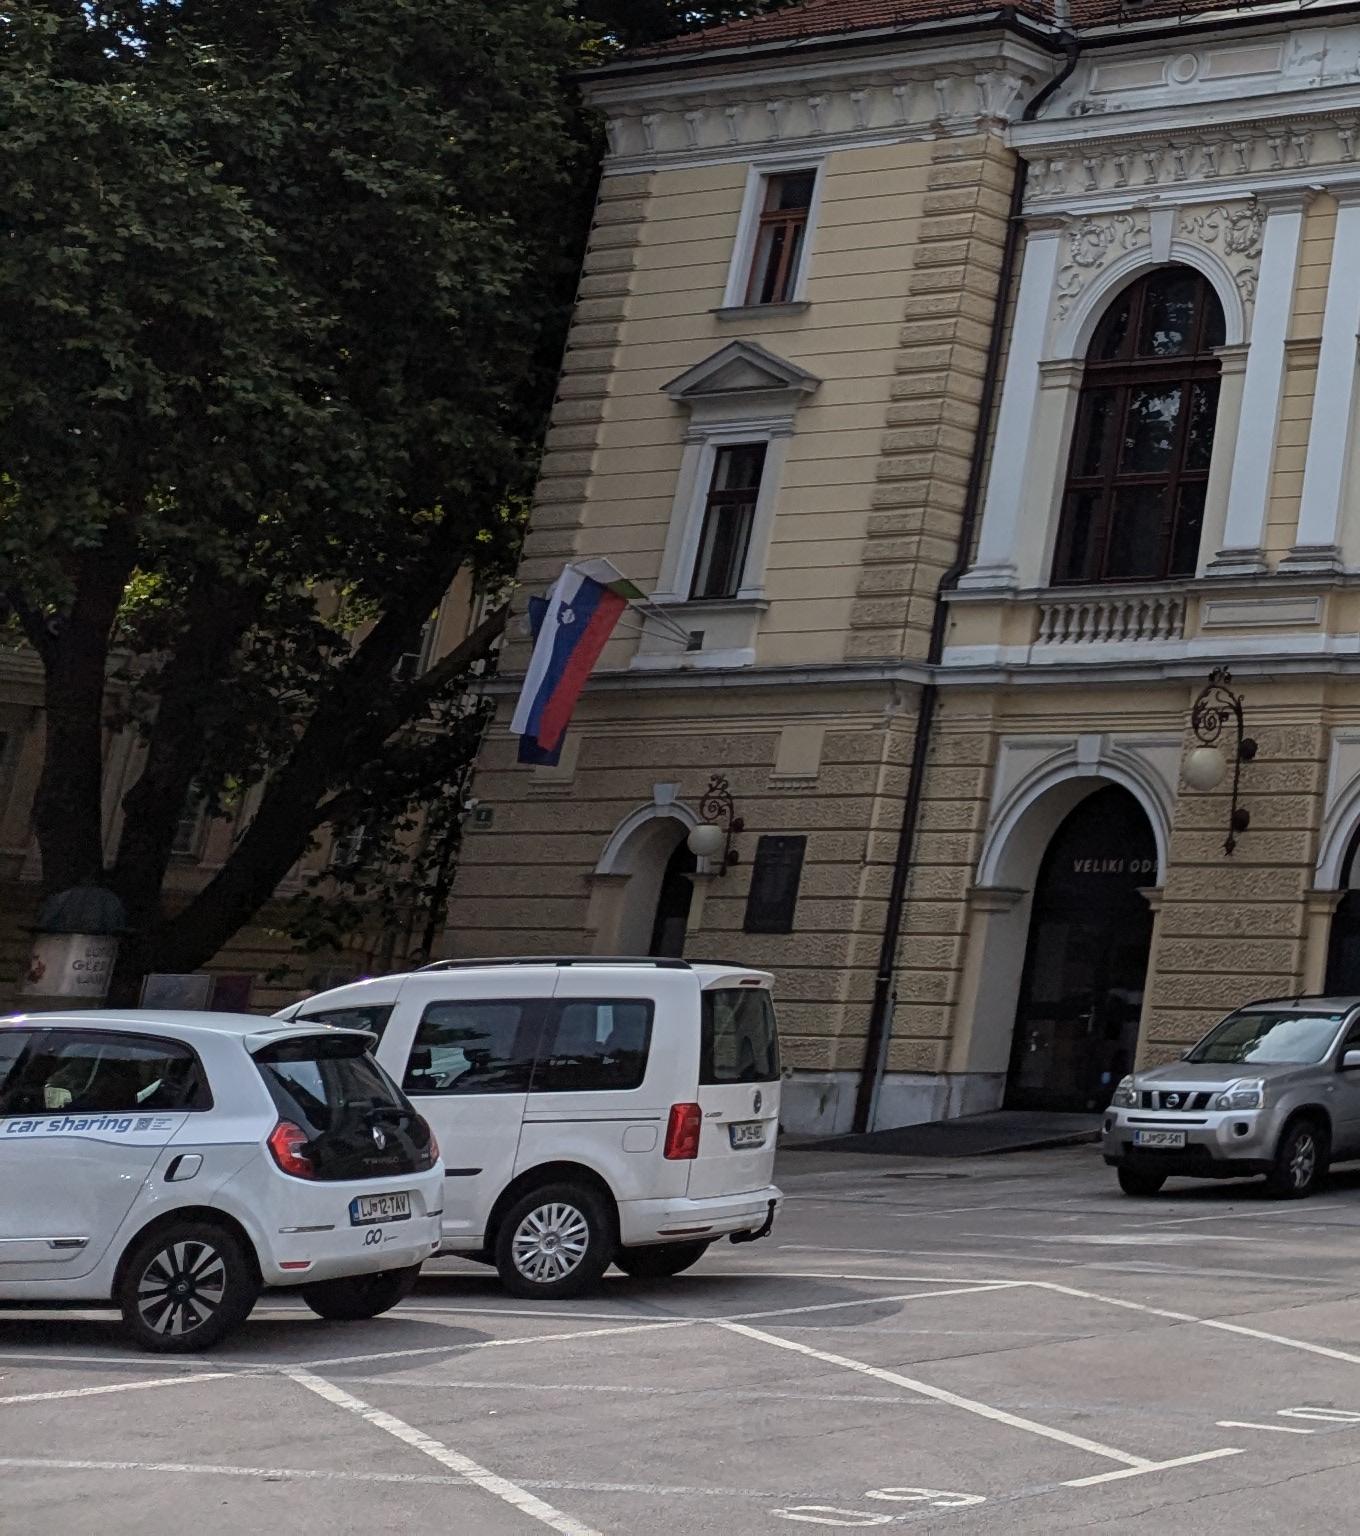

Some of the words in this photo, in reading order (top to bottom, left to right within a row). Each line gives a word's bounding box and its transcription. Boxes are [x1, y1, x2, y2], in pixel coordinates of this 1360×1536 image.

[1073, 859, 1124, 873] VELIKI
[6, 1120, 44, 1134] car
[46, 1115, 133, 1133] sharing
[361, 1199, 373, 1218] LJ
